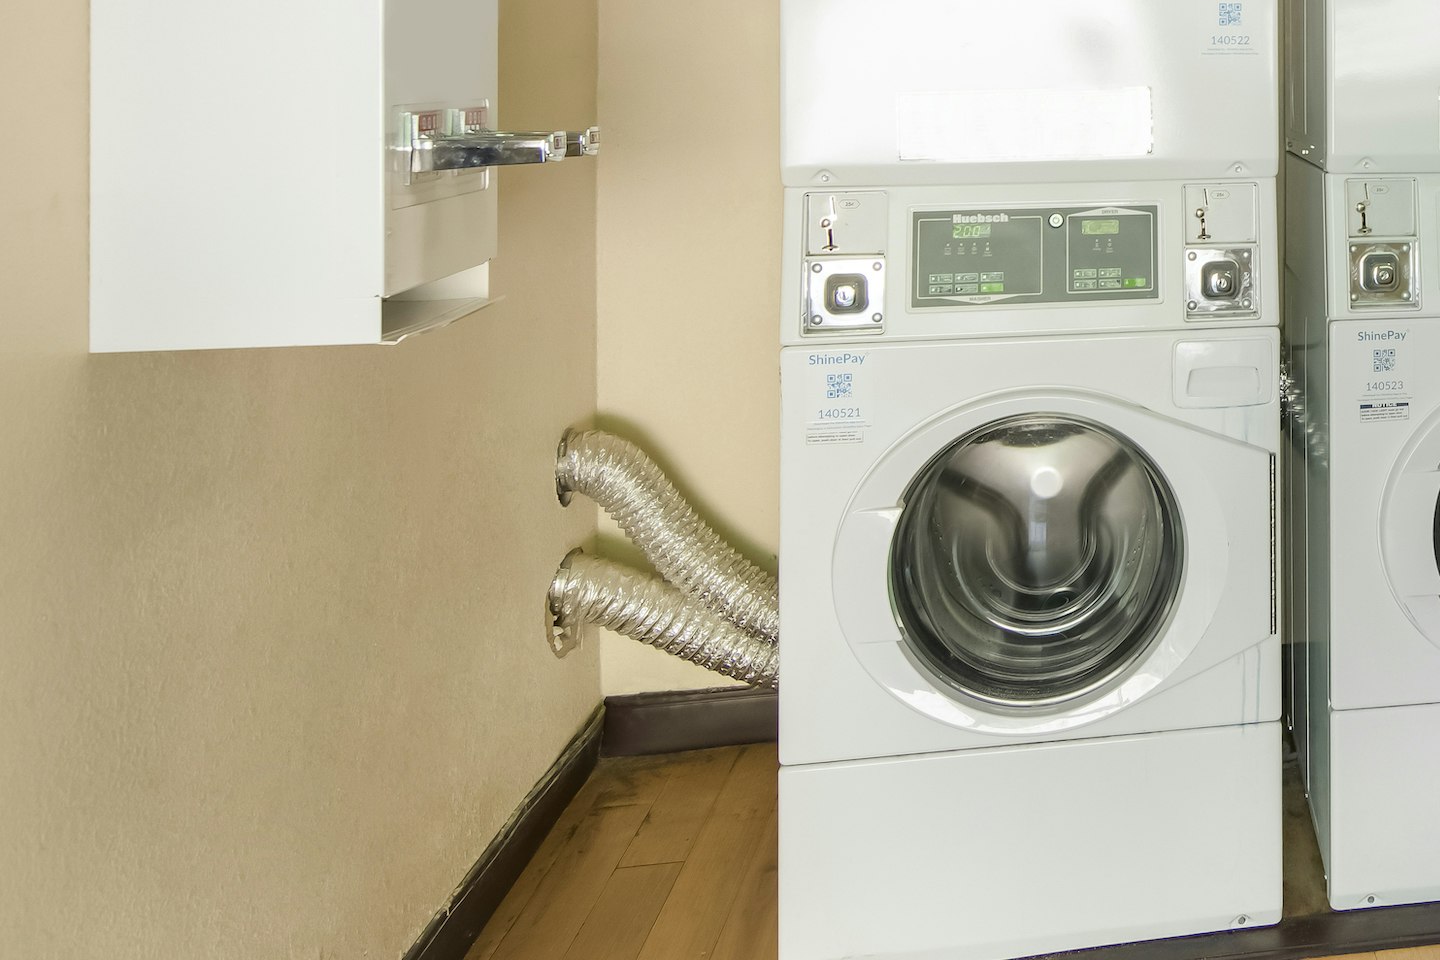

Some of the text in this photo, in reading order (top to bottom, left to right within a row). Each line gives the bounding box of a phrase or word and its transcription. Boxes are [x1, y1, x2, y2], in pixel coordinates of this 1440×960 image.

[1211, 35, 1250, 45] 140522
[952, 212, 1009, 223] Huebsch
[1357, 330, 1407, 341] ShinePay
[808, 353, 866, 365] ShinePay
[1366, 381, 1404, 391] 140523
[818, 407, 861, 419] 140521
